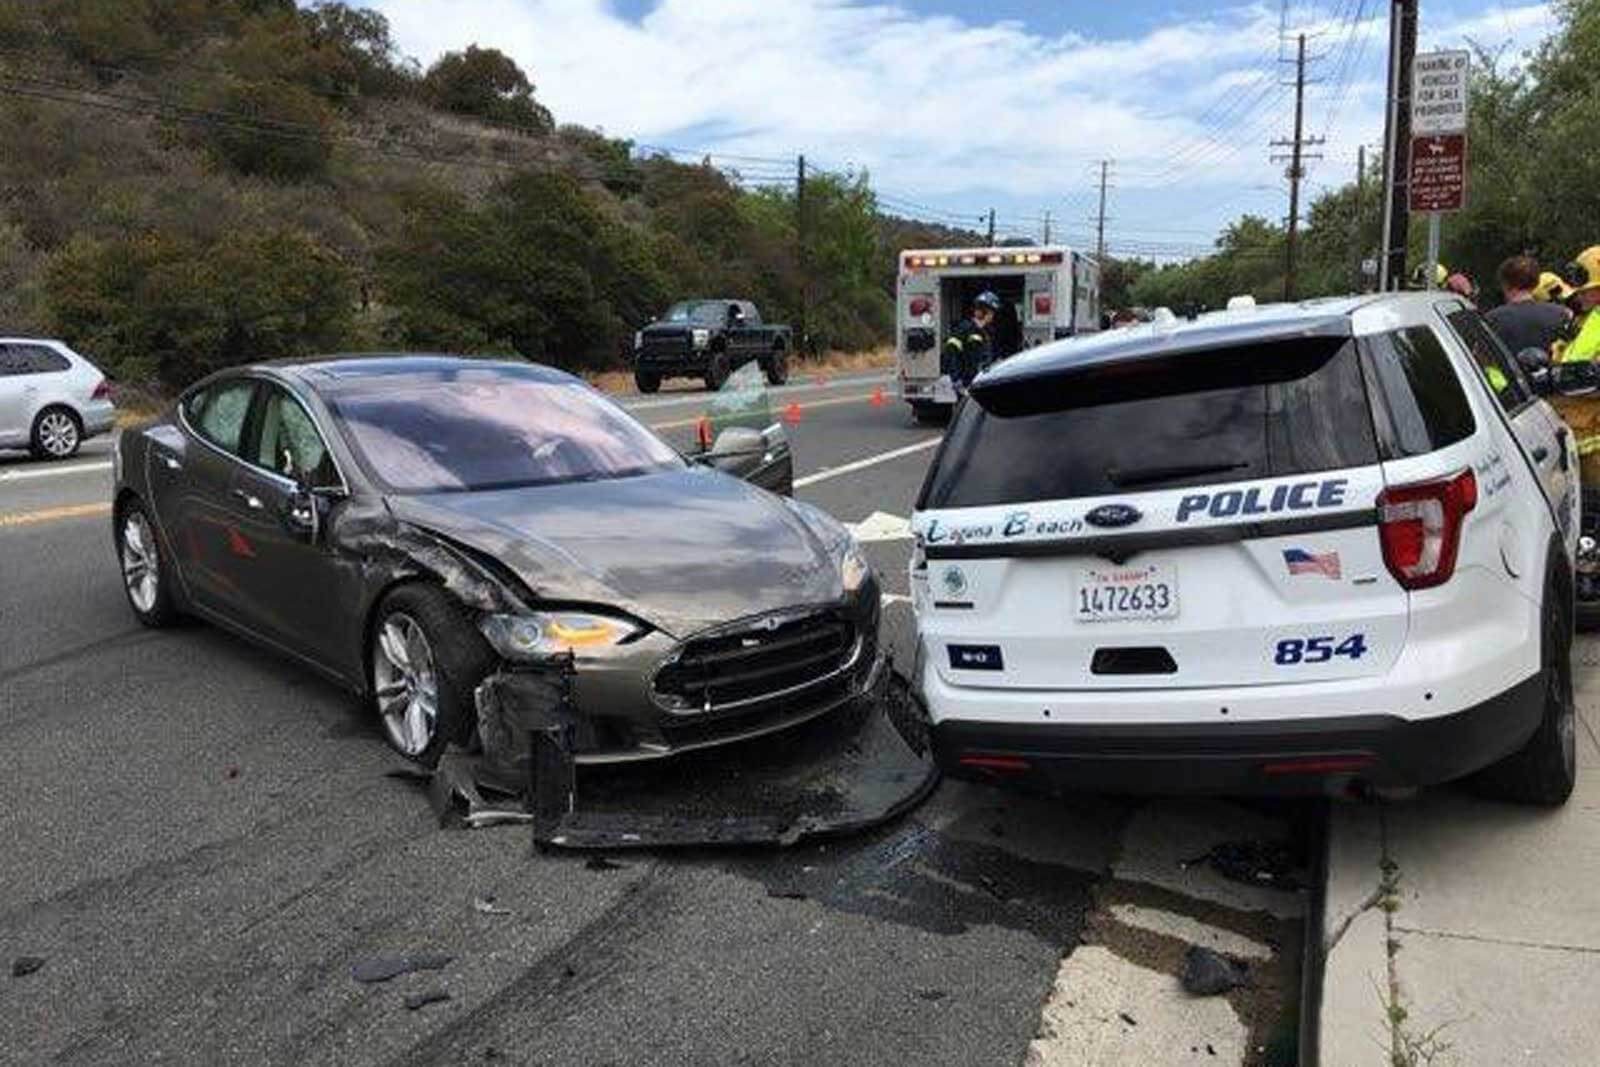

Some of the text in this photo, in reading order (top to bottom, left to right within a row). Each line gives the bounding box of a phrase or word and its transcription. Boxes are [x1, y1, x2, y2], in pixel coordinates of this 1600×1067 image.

[1175, 479, 1349, 523] POLICE
[1079, 583, 1170, 613] 1472633
[1274, 634, 1368, 665] 854
